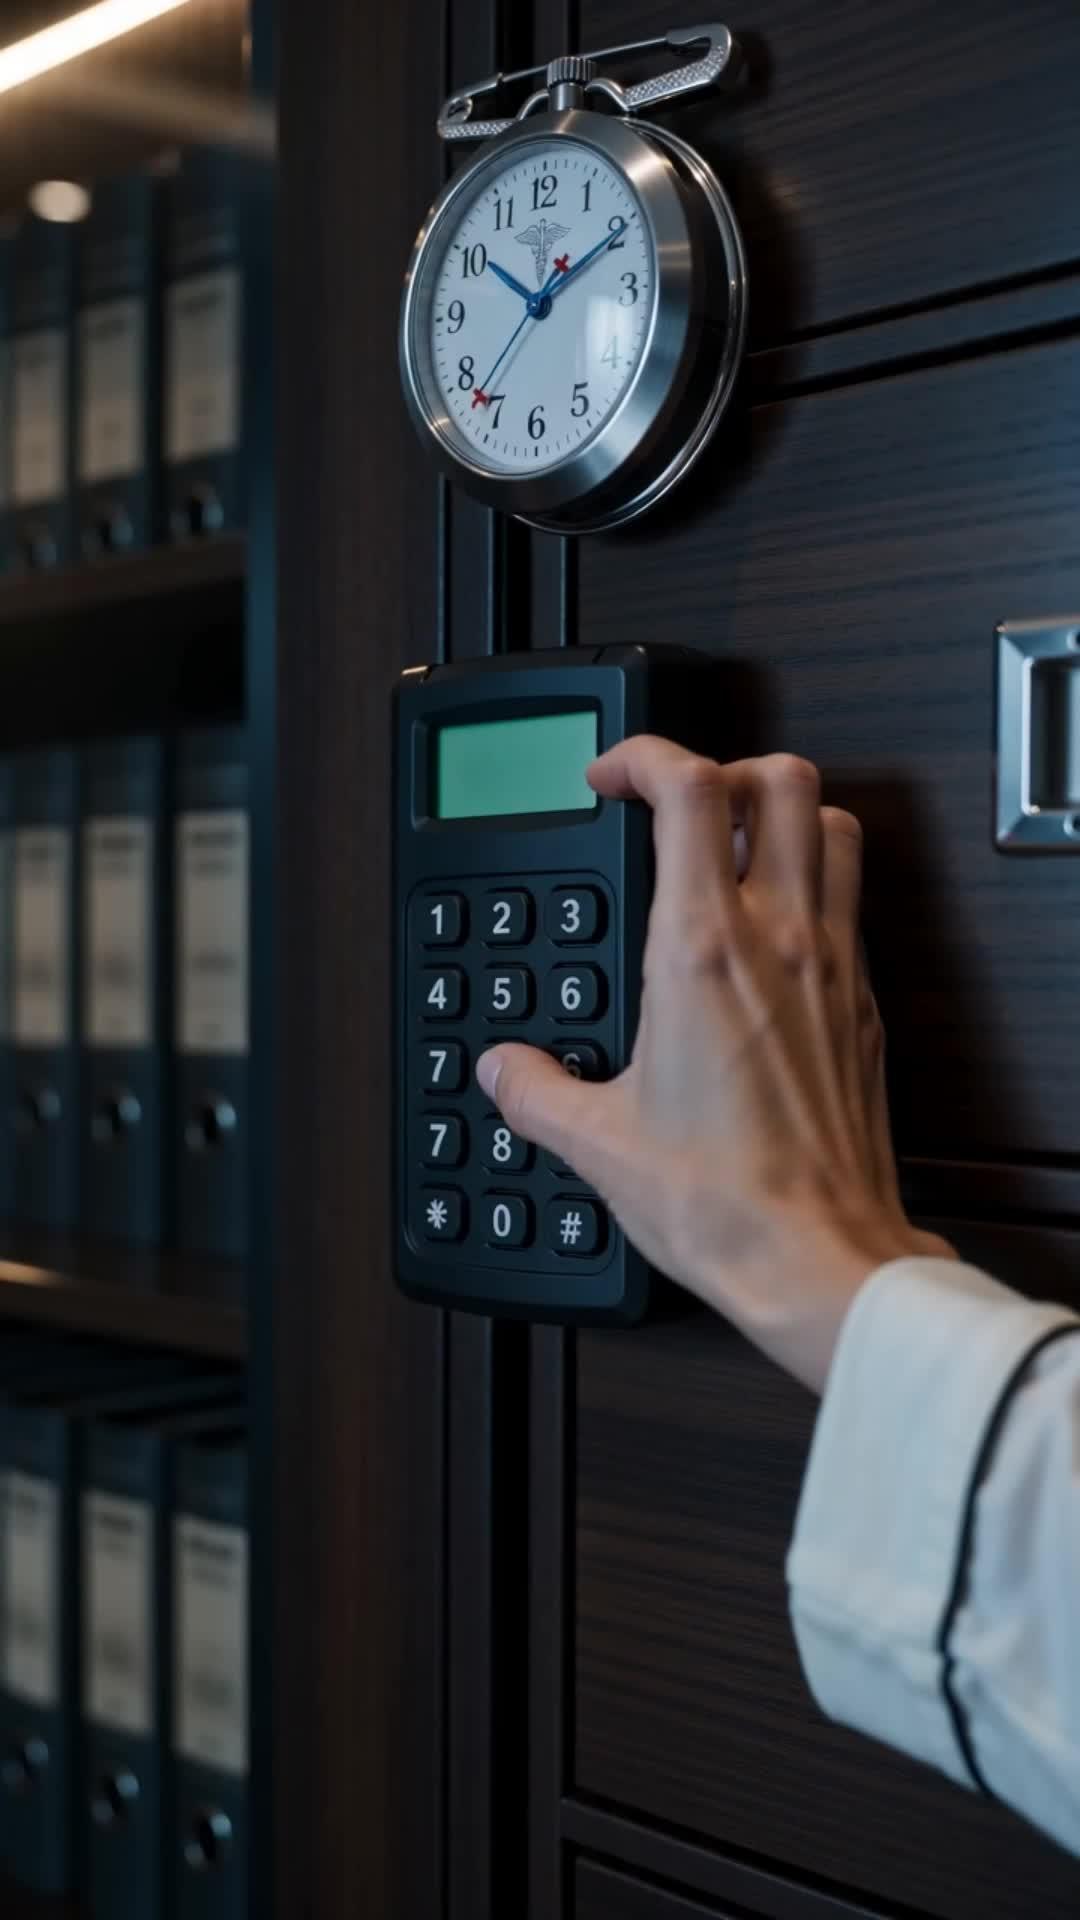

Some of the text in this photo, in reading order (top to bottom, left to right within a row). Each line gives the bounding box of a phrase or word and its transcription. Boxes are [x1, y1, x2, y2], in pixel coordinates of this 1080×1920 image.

[531, 174, 558, 210] 12
[580, 179, 592, 212] 1
[494, 196, 514, 231] 11
[607, 215, 626, 251] 2
[462, 243, 487, 279] 10
[619, 272, 638, 307] 3
[447, 300, 465, 333] 9
[600, 335, 622, 370] 4
[458, 356, 475, 391] 8
[487, 395, 505, 430] 7
[570, 382, 589, 417] 5
[527, 405, 546, 440] 6
[430, 903, 443, 935] 1
[492, 901, 511, 934] 2
[560, 899, 580, 933] 3
[427, 977, 447, 1010] 4
[492, 977, 511, 1010] 5
[560, 976, 581, 1010] 6
[429, 1050, 447, 1083] 7
[429, 1124, 447, 1157] 7
[492, 1127, 511, 1162] 8
[492, 1204, 511, 1237] 0
